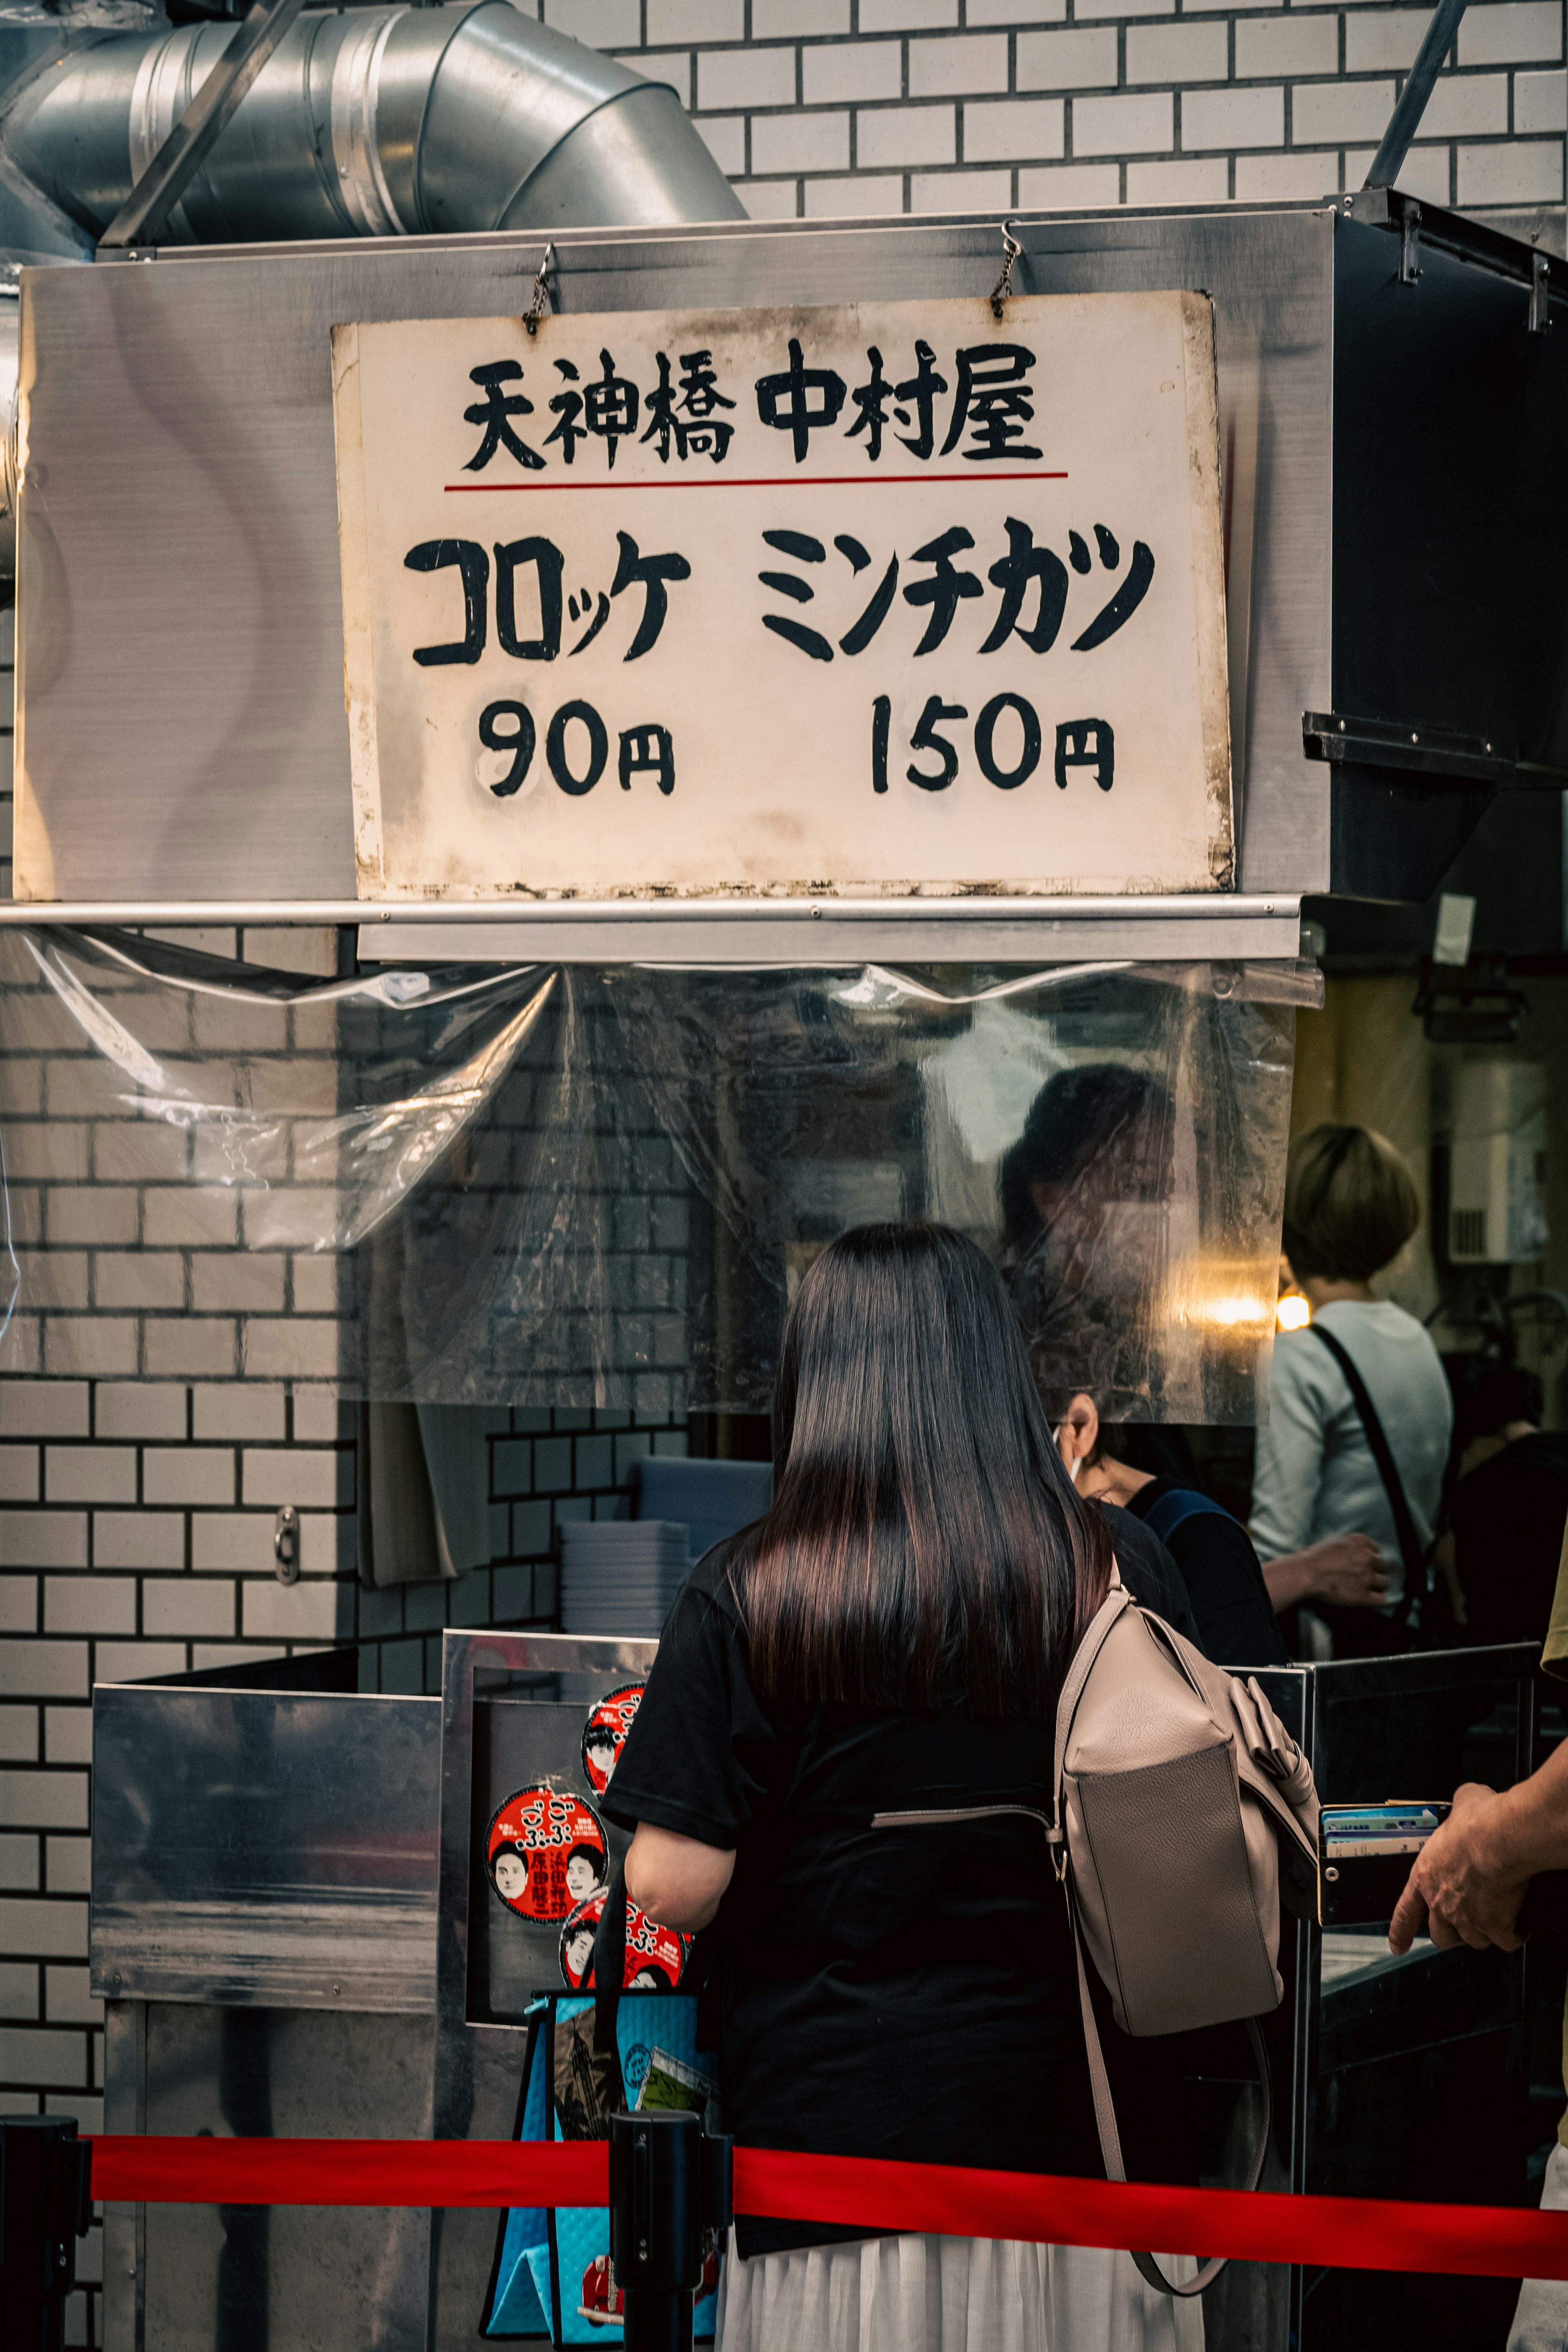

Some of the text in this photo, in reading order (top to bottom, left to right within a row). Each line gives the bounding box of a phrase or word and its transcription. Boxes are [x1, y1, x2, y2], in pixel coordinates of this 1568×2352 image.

[463, 338, 1043, 471] 天神橋 中村屋
[404, 531, 690, 666] コロッケ
[758, 517, 1154, 662] ミンチカツ
[479, 700, 675, 797] 90円
[873, 693, 1114, 793] 150円
